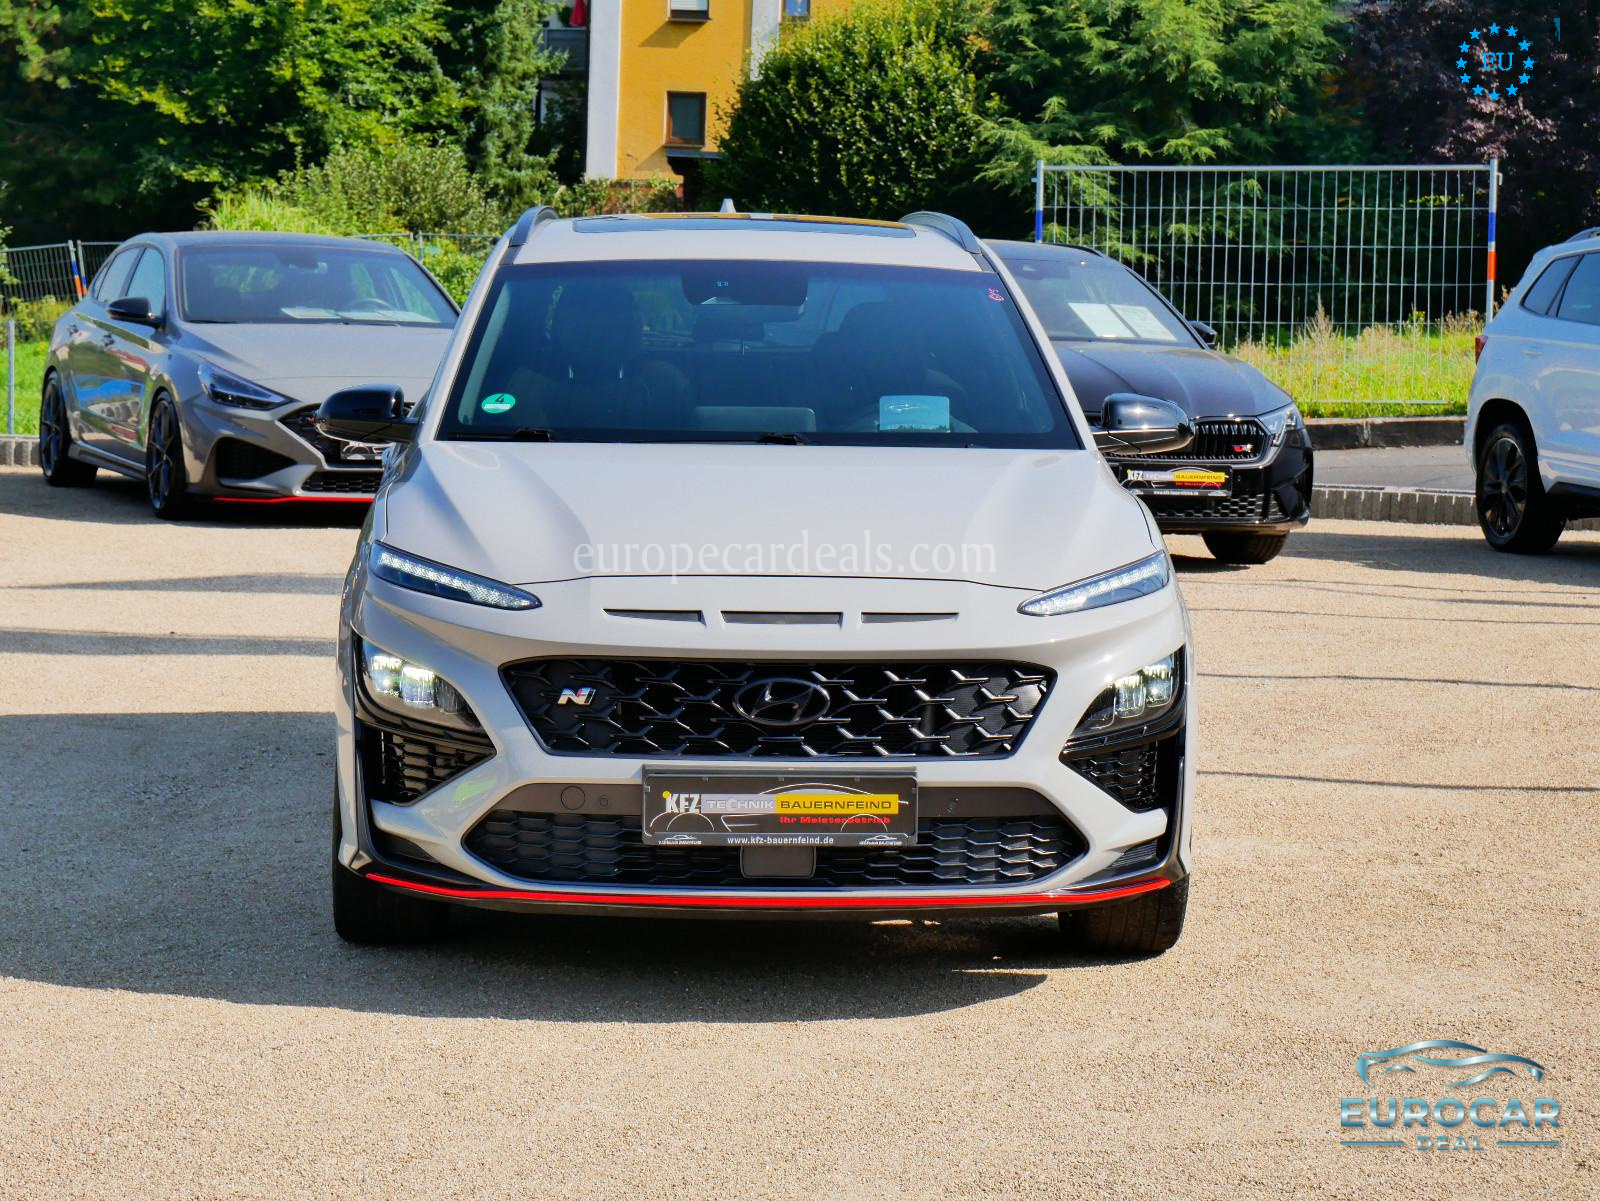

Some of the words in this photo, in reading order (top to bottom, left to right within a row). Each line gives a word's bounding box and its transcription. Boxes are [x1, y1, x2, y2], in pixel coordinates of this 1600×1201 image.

[665, 793, 700, 813] KFZ
[706, 799, 774, 811] TECHNIK
[780, 800, 892, 810] BAUERNFEIND
[780, 816, 797, 824] Ihr
[727, 836, 834, 845] www.kfz-bauernfeind.de
